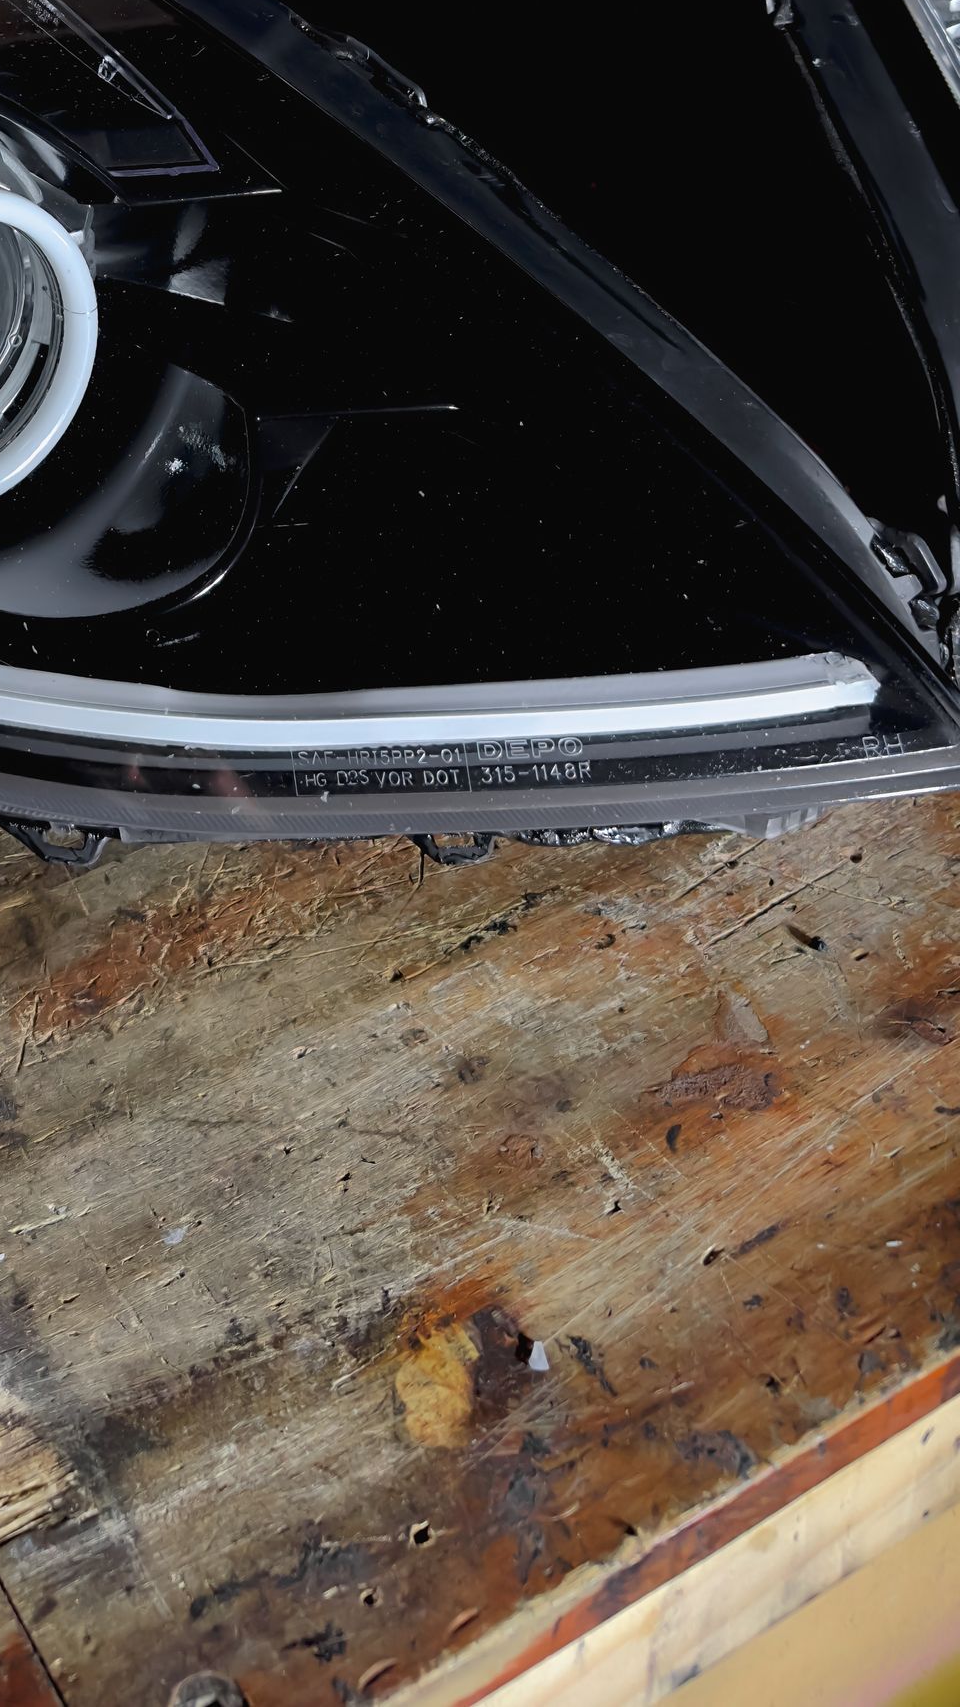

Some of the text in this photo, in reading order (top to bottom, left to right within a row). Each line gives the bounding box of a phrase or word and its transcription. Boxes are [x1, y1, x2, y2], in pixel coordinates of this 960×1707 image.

[477, 737, 583, 760] DEPO
[862, 733, 904, 760] RH
[423, 768, 460, 786] DOT
[481, 761, 591, 783] 315-1148R
